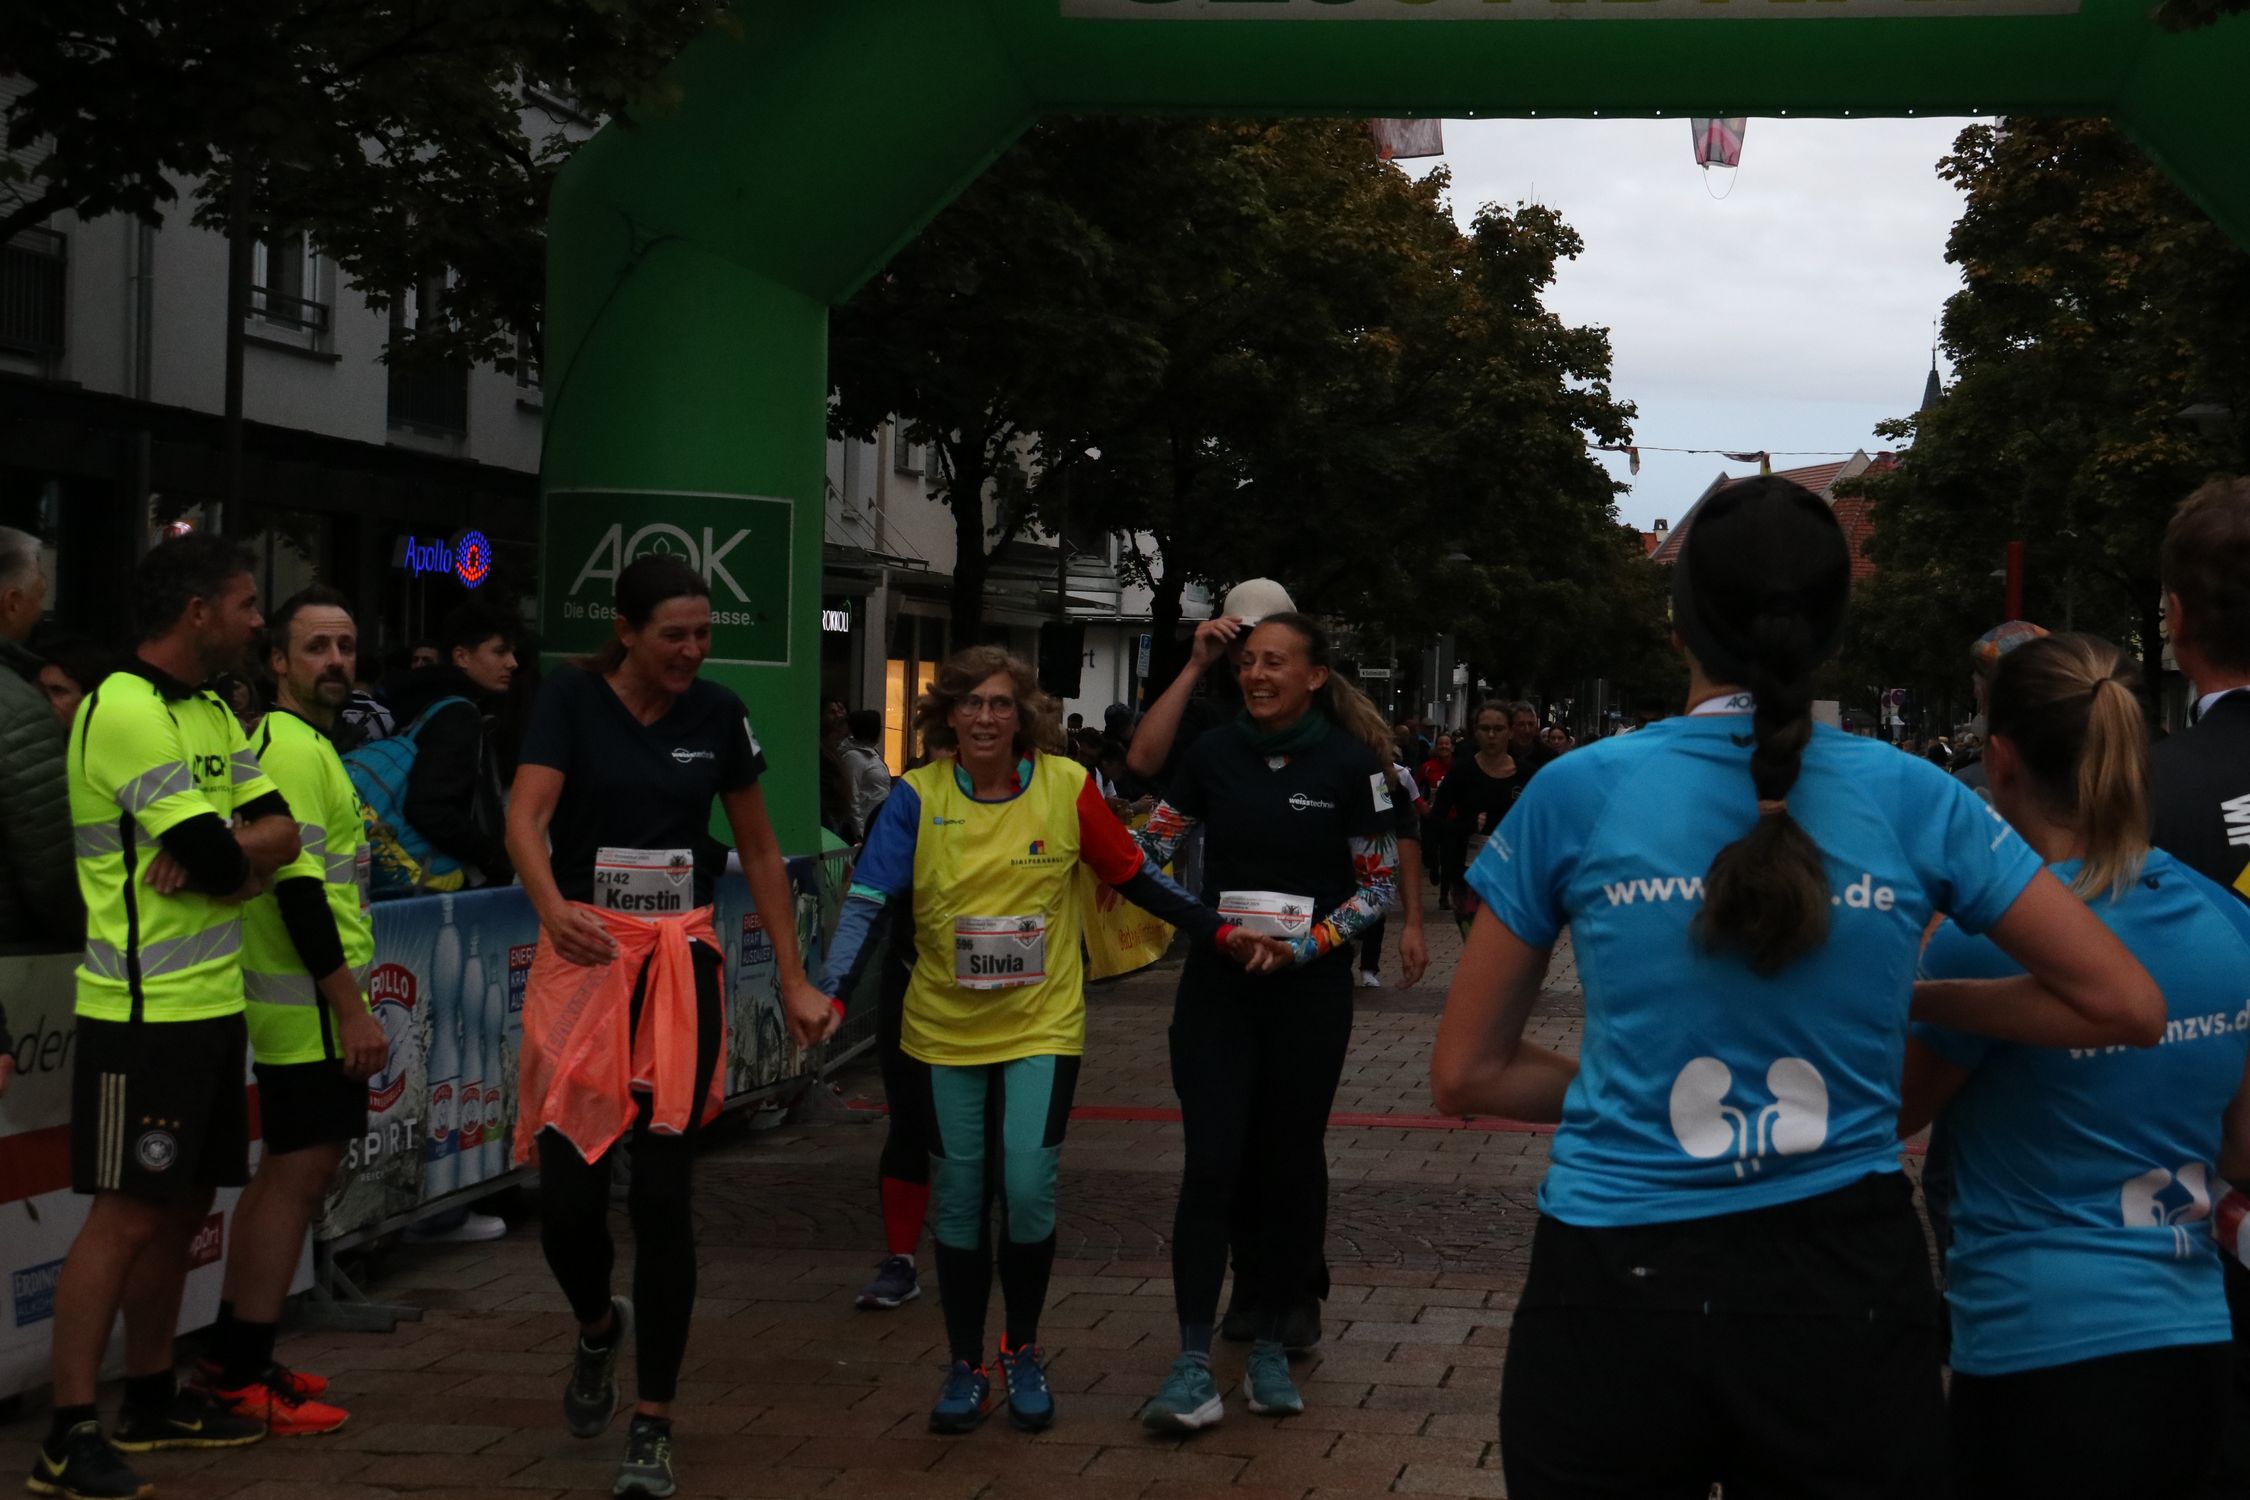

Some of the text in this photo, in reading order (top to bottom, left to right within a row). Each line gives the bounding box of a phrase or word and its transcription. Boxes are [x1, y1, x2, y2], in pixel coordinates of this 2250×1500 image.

[403, 534, 453, 579] Apollo
[568, 523, 752, 603] AOK
[564, 602, 585, 619] Die
[597, 871, 629, 885] 2142
[606, 889, 680, 911] Kerstin
[970, 954, 1024, 975] Silvia
[371, 970, 410, 1000] POLLO
